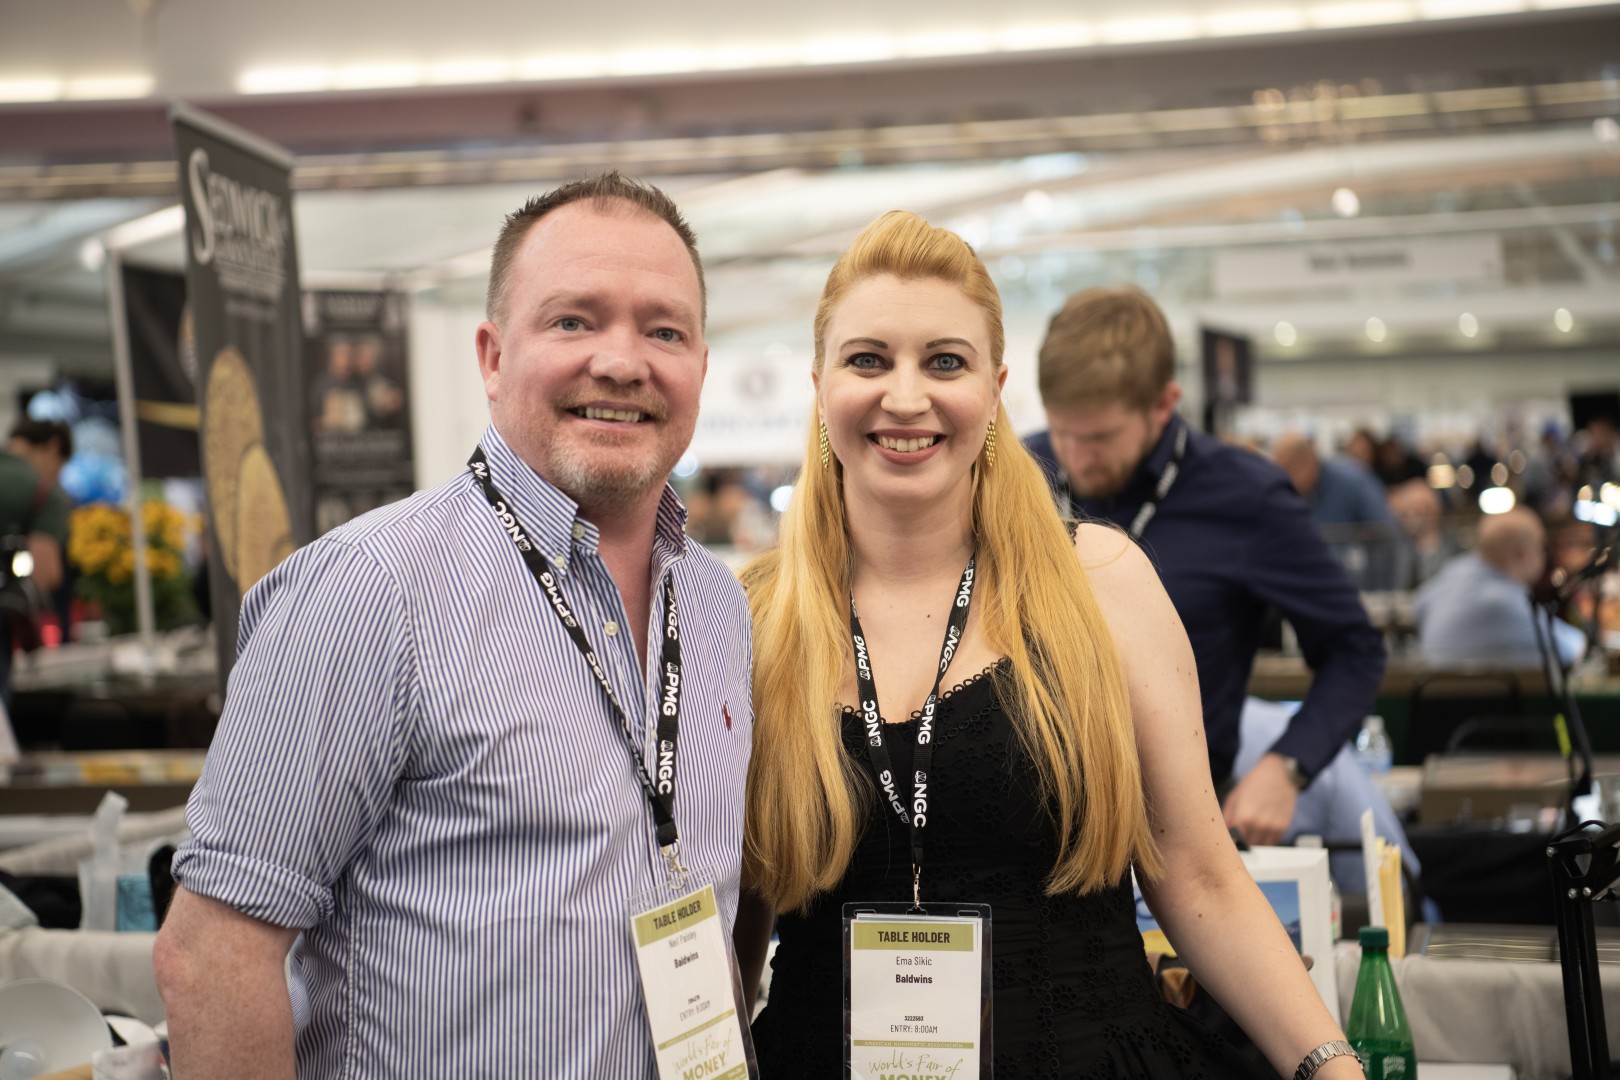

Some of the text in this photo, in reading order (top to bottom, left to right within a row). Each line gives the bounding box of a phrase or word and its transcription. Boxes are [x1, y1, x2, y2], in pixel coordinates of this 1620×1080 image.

[492, 501, 524, 541] NGC
[540, 571, 570, 618] PMG
[957, 567, 973, 607] PMG
[667, 598, 678, 640] NGC
[853, 635, 870, 671] PMG
[940, 635, 958, 673] NGC
[662, 673, 679, 716] PMG
[863, 700, 881, 738] NGC
[918, 701, 936, 745] PMG
[658, 752, 673, 795] NGC
[880, 769, 904, 814] PMG
[913, 784, 927, 828] NGC
[653, 900, 701, 930] TABLE HOLDER
[878, 931, 950, 943] TABLE HOLDER
[674, 952, 699, 968] Baldwins
[895, 974, 933, 984] Baldwins
[896, 956, 932, 966] Ema Sikic
[890, 1025, 938, 1034] ENTRY: 8:00AM
[683, 1051, 726, 1080] MONEY
[869, 1049, 964, 1080] World's Fair of
